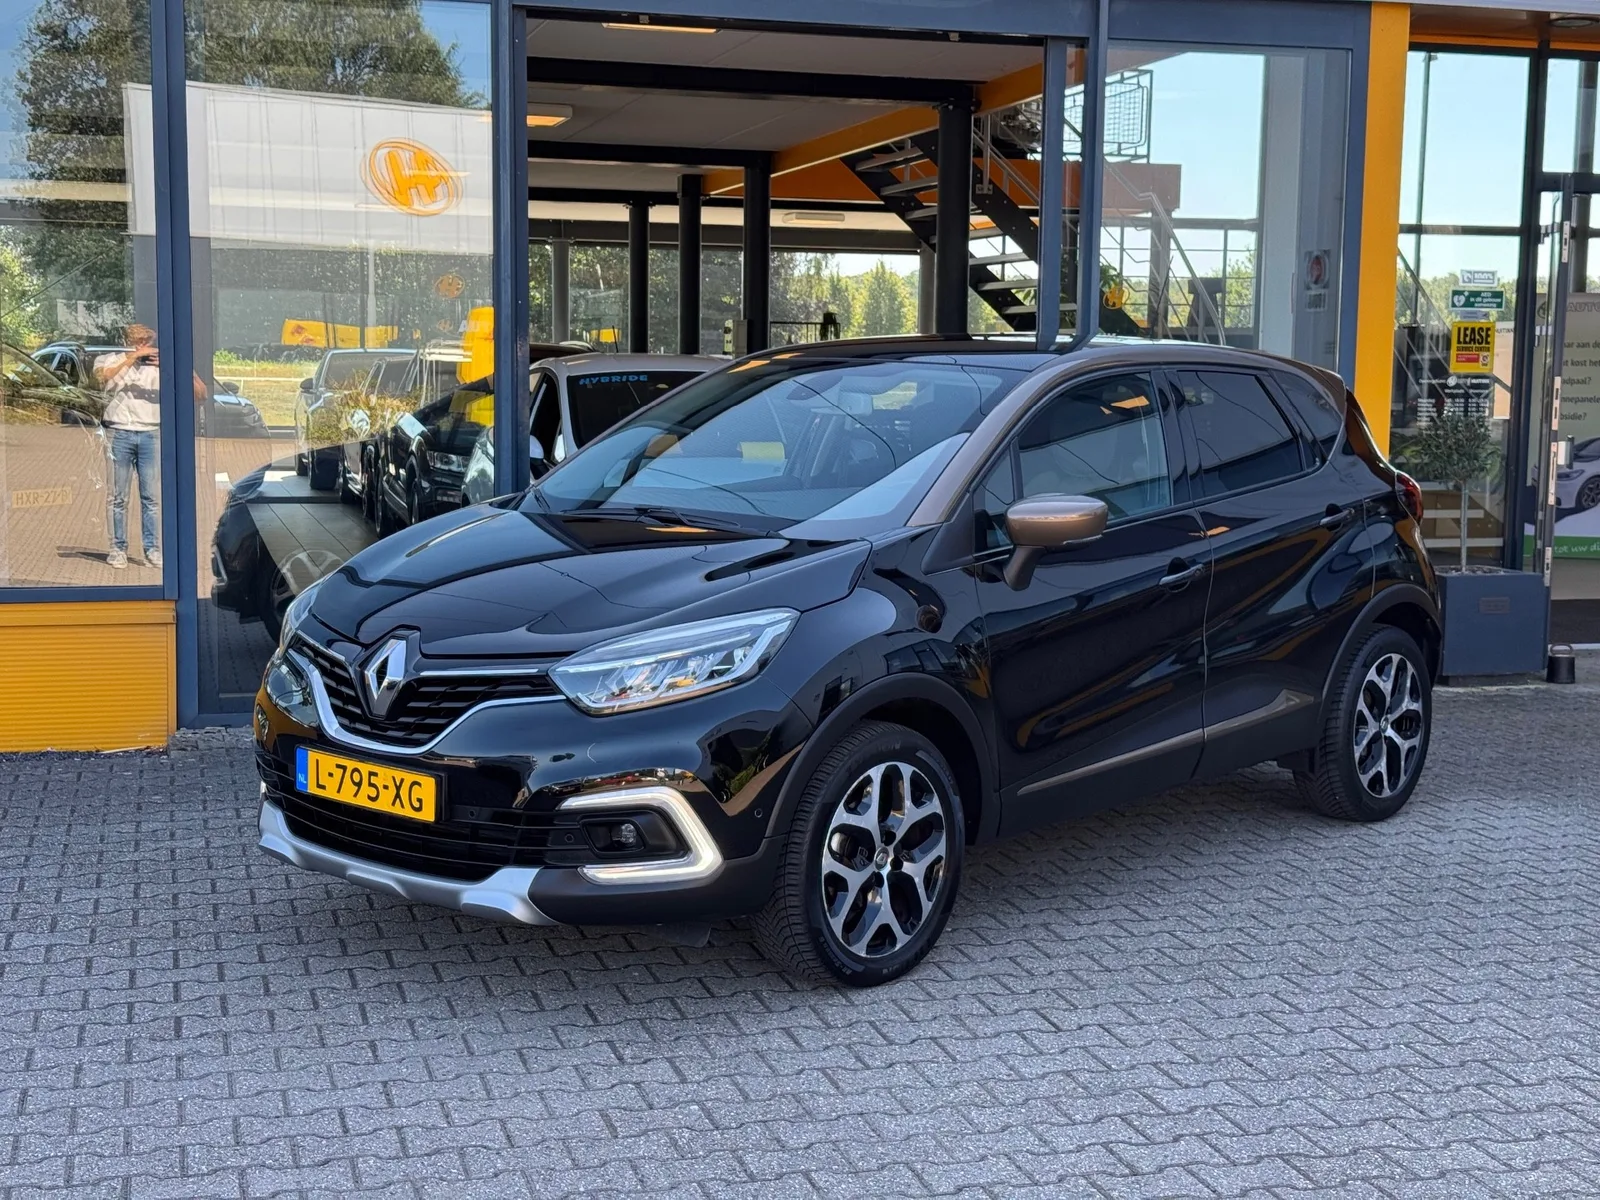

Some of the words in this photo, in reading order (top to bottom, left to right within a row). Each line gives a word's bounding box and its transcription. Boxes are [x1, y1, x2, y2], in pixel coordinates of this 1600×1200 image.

[1457, 327, 1491, 345] LEASE
[1570, 358, 1587, 366] kost
[579, 375, 648, 385] HYBRIDE
[298, 772, 307, 784] NL
[315, 758, 424, 813] L-795-XG
